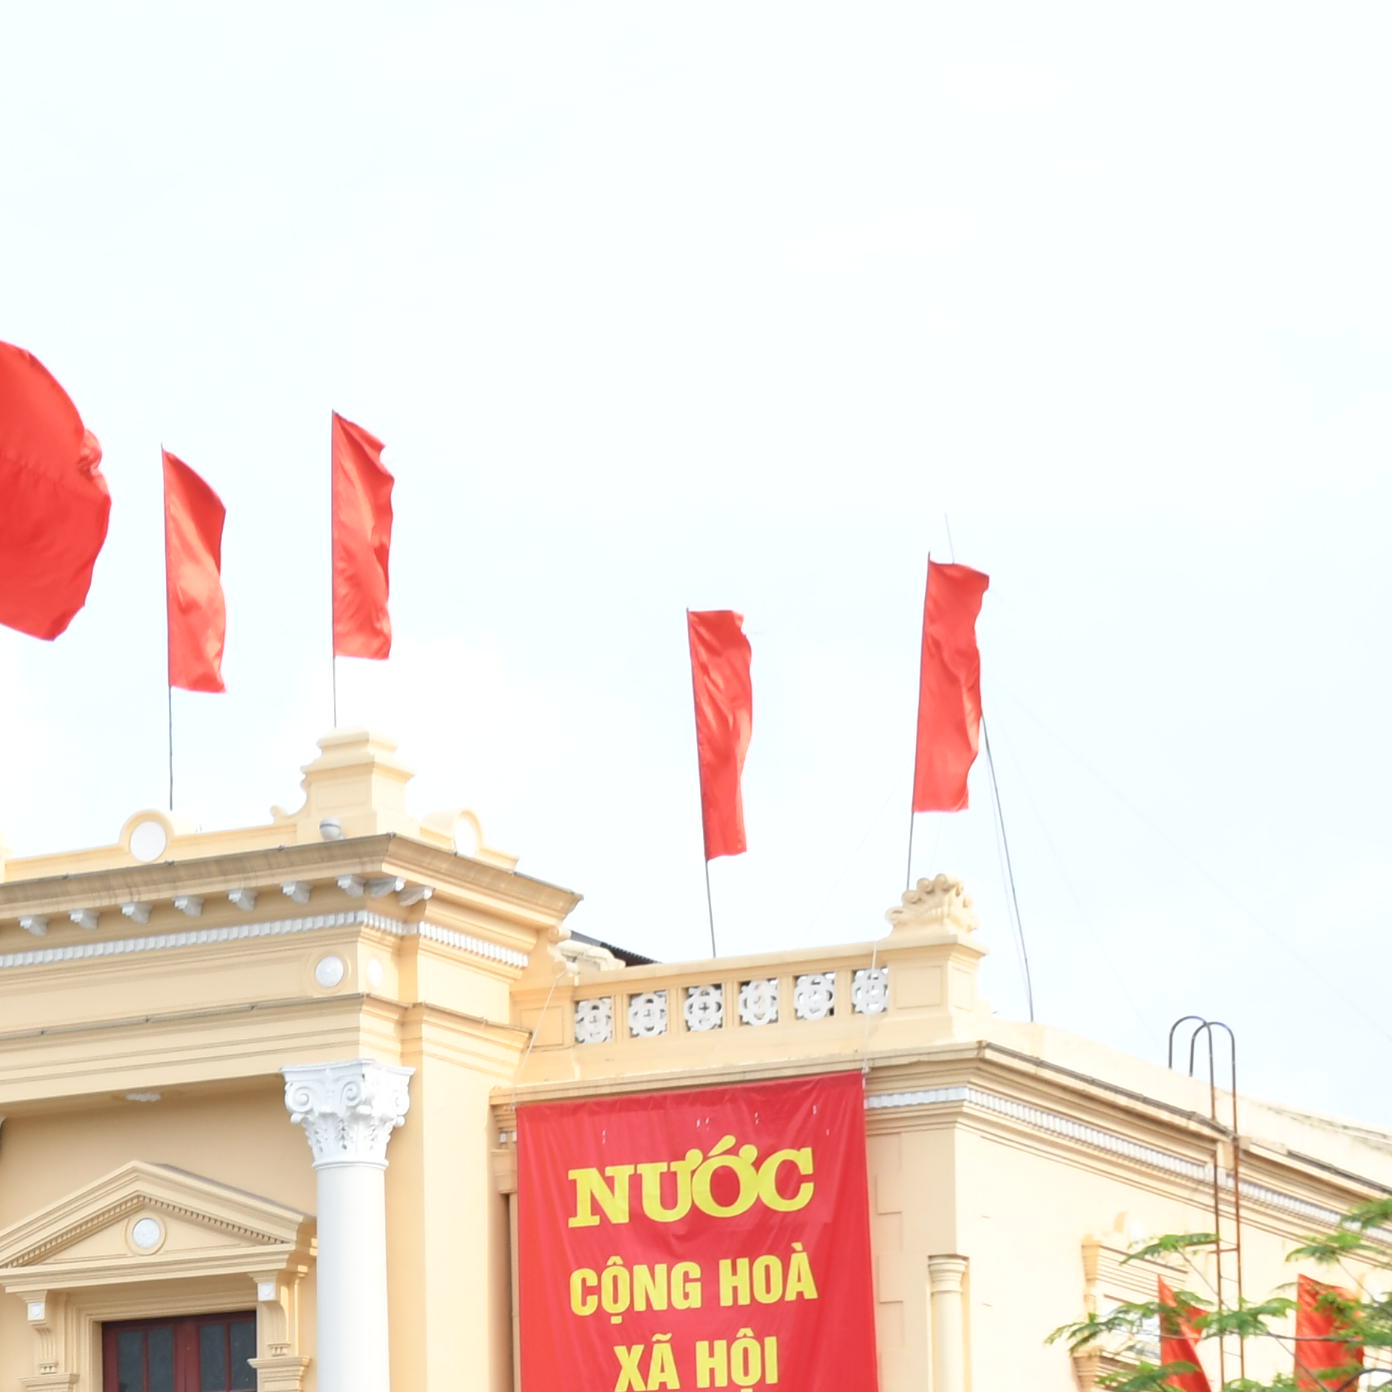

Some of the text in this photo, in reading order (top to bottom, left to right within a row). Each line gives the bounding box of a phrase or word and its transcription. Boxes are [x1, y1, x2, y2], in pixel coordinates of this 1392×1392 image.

[567, 1134, 816, 1229] NƯỚC
[569, 1241, 819, 1325] CỘNG HOÀ
